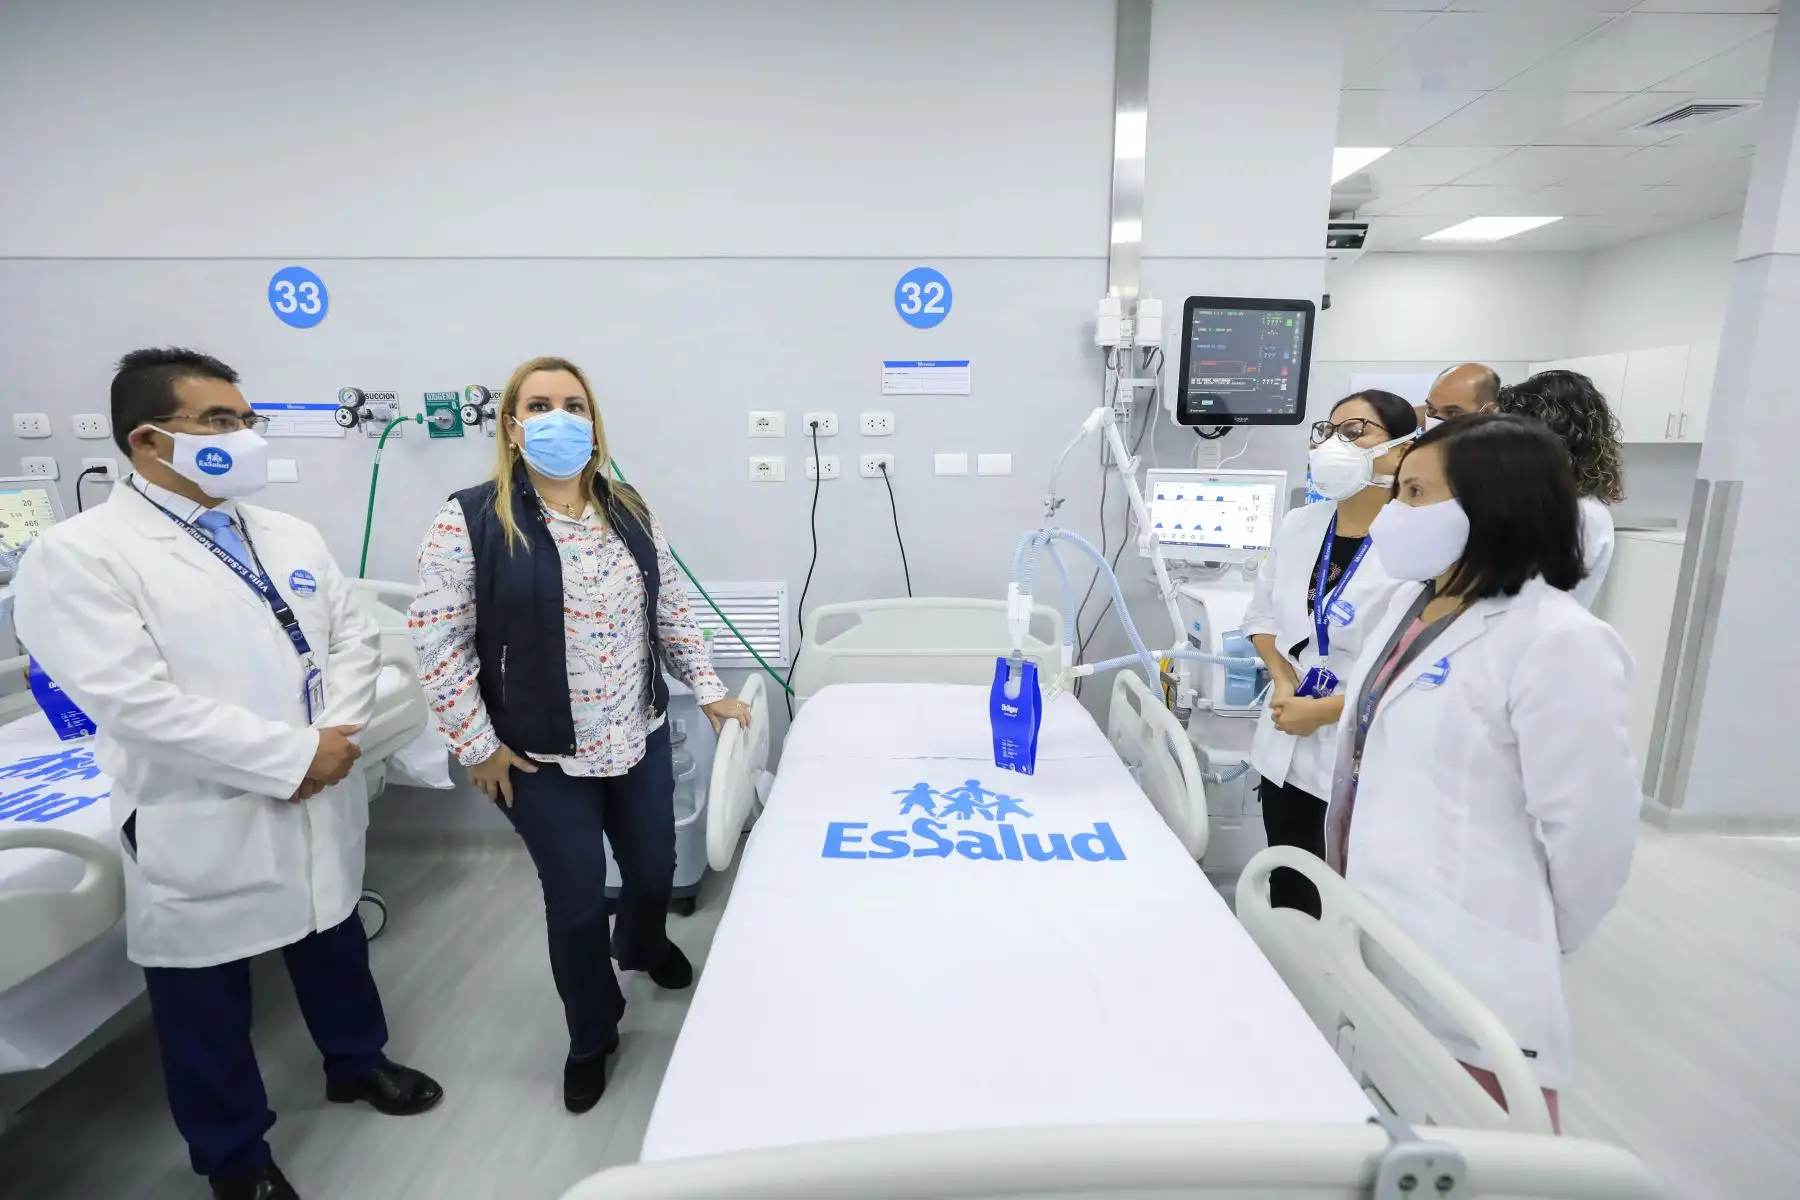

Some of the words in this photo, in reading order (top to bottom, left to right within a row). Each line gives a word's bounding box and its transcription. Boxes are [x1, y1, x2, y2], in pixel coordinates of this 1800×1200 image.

[275, 280, 321, 315] 33
[900, 281, 945, 315] 32
[426, 391, 456, 401] OXIGENO
[211, 547, 249, 576] EsSalud
[249, 573, 269, 593] Villa
[821, 817, 1127, 861] EsSalud
